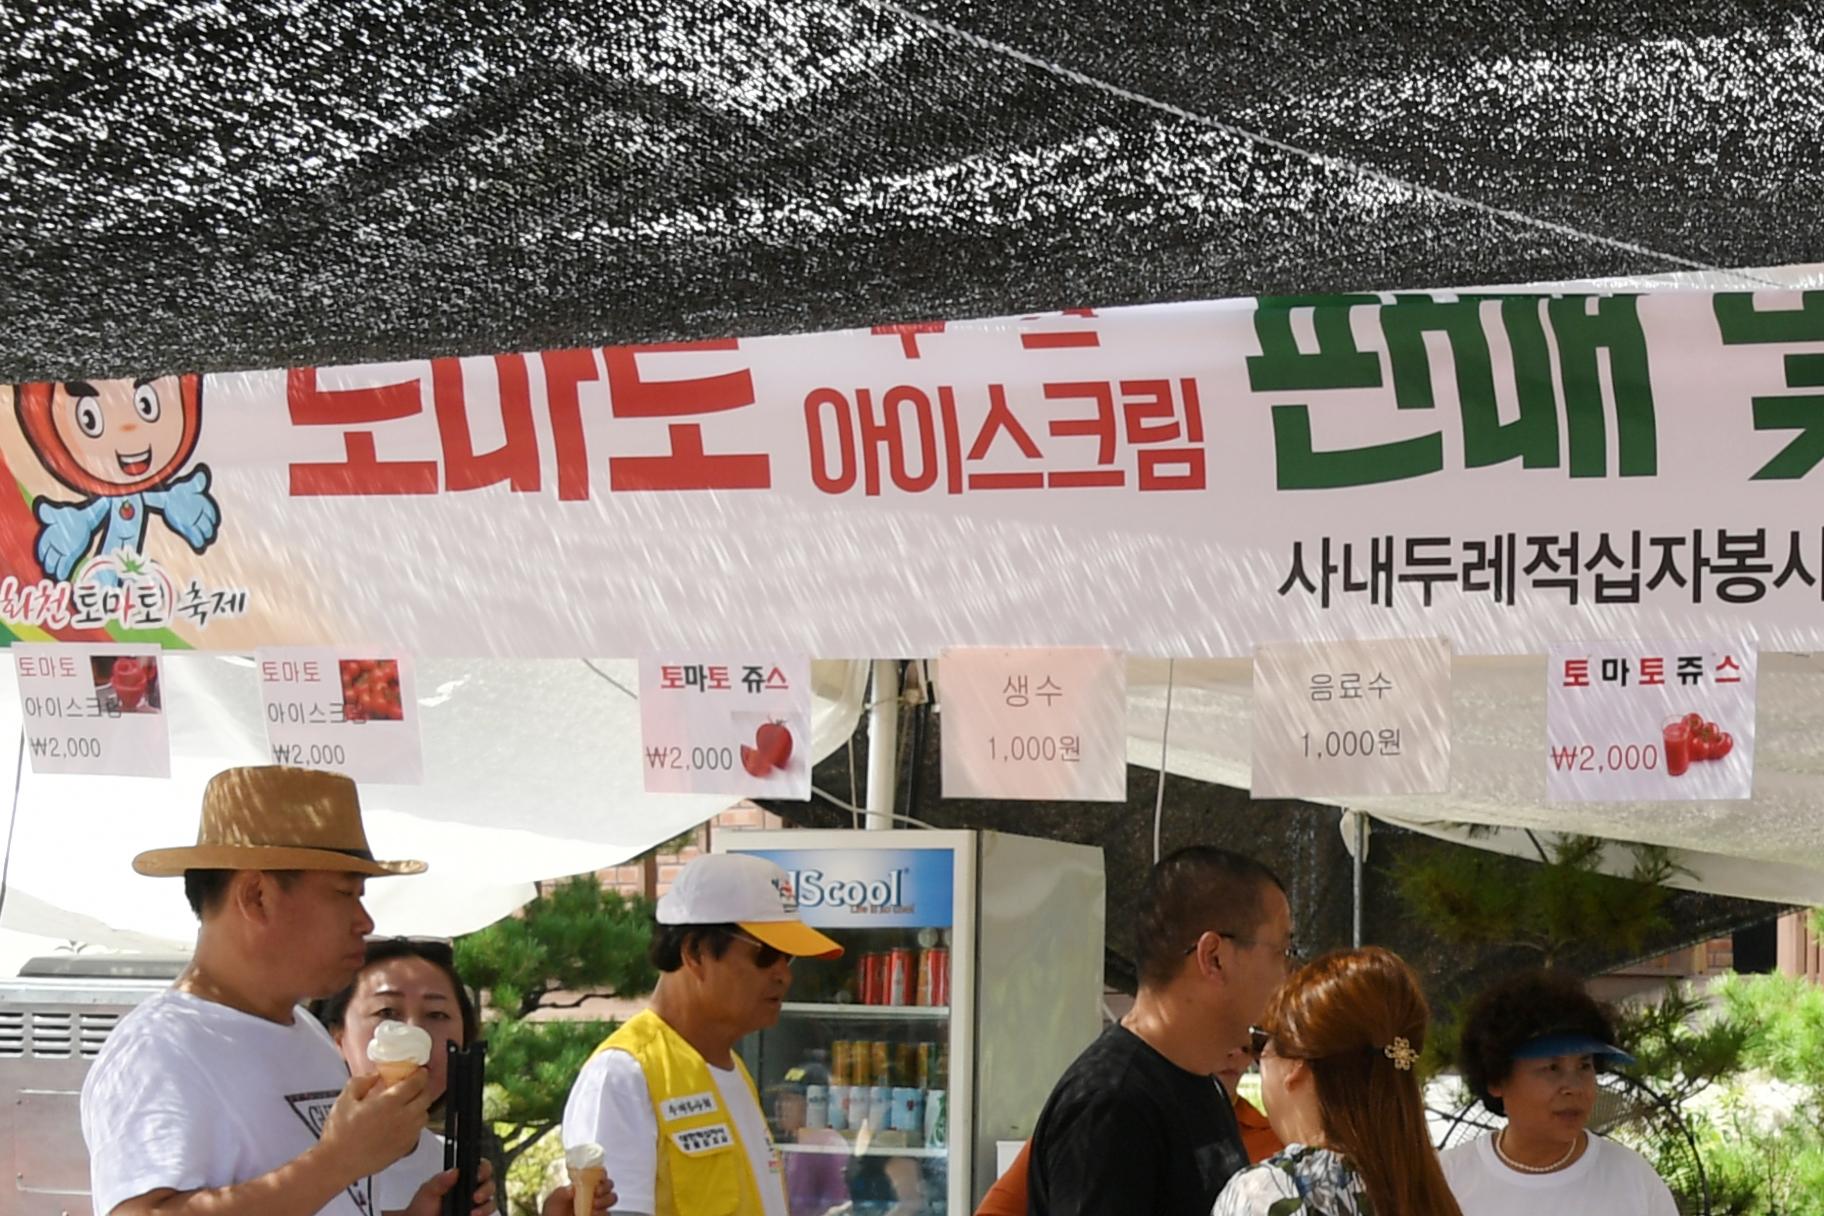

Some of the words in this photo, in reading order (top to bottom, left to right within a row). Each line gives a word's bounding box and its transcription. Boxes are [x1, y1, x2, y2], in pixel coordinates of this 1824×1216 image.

[803, 377, 1207, 496] 아이스크림
[177, 580, 247, 626] 축제
[18, 656, 77, 678] 토마토
[262, 660, 321, 683] 토마토
[661, 664, 732, 693] 토마토
[741, 665, 789, 694] 쥬스
[1003, 675, 1063, 707] 생수
[1309, 671, 1393, 701] 음료수
[25, 696, 123, 719] 아이스크림
[29, 737, 102, 759] ₩2,000
[272, 743, 345, 766] ₩2,000
[988, 735, 1081, 763] 1,000원
[1301, 728, 1401, 760] 1,000원
[646, 746, 733, 771] ₩2,000
[1550, 744, 1657, 773] ₩2,000
